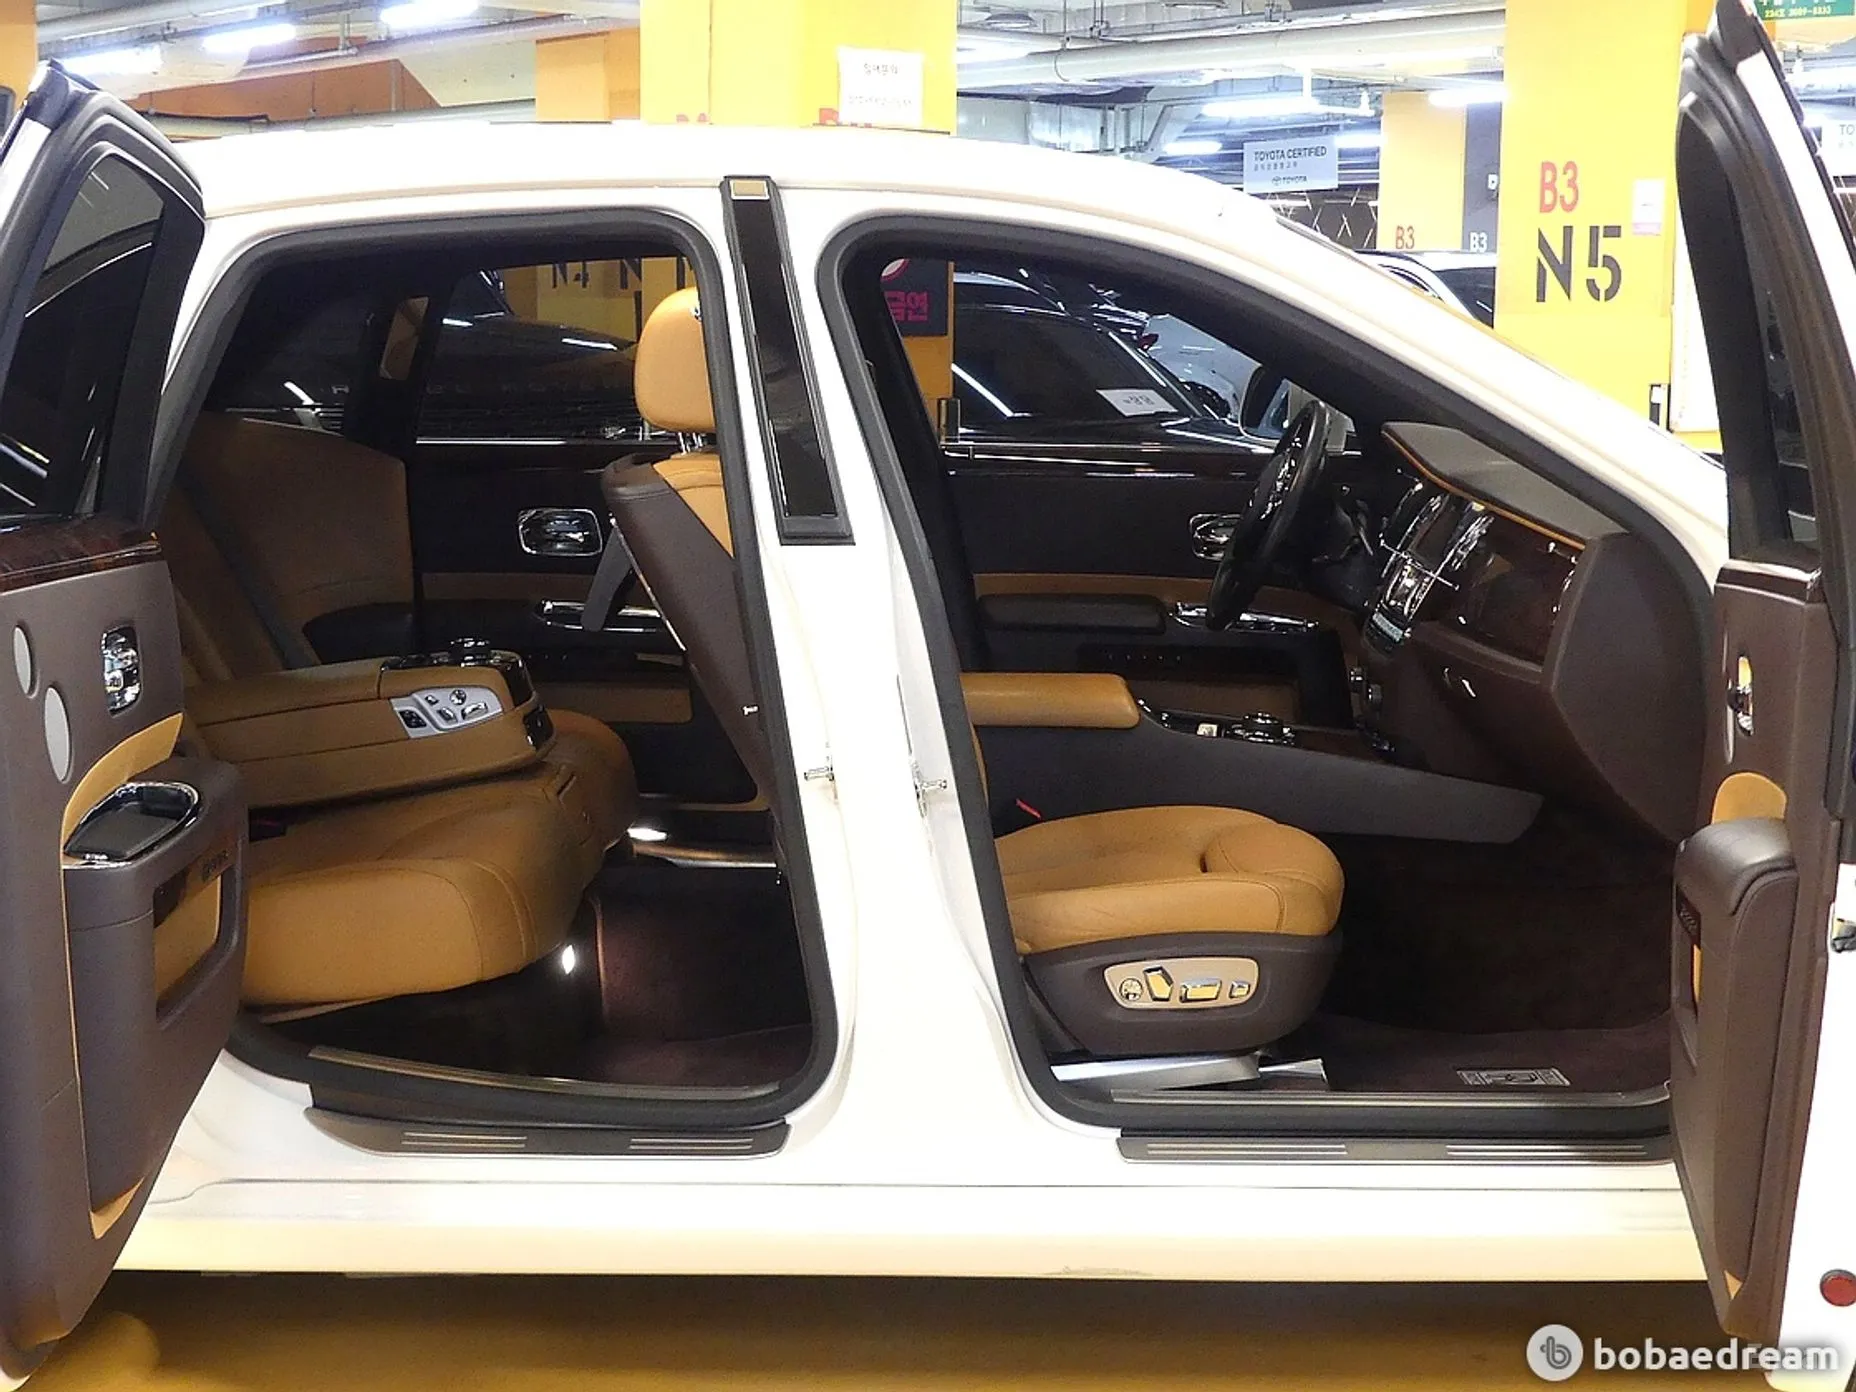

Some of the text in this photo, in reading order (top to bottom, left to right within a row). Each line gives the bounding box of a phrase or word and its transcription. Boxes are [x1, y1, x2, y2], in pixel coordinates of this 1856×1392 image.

[1254, 146, 1327, 161] TOYOTA CERTIFIED
[1539, 160, 1579, 213] B3
[1395, 225, 1415, 250] B3
[1469, 231, 1488, 253] B3
